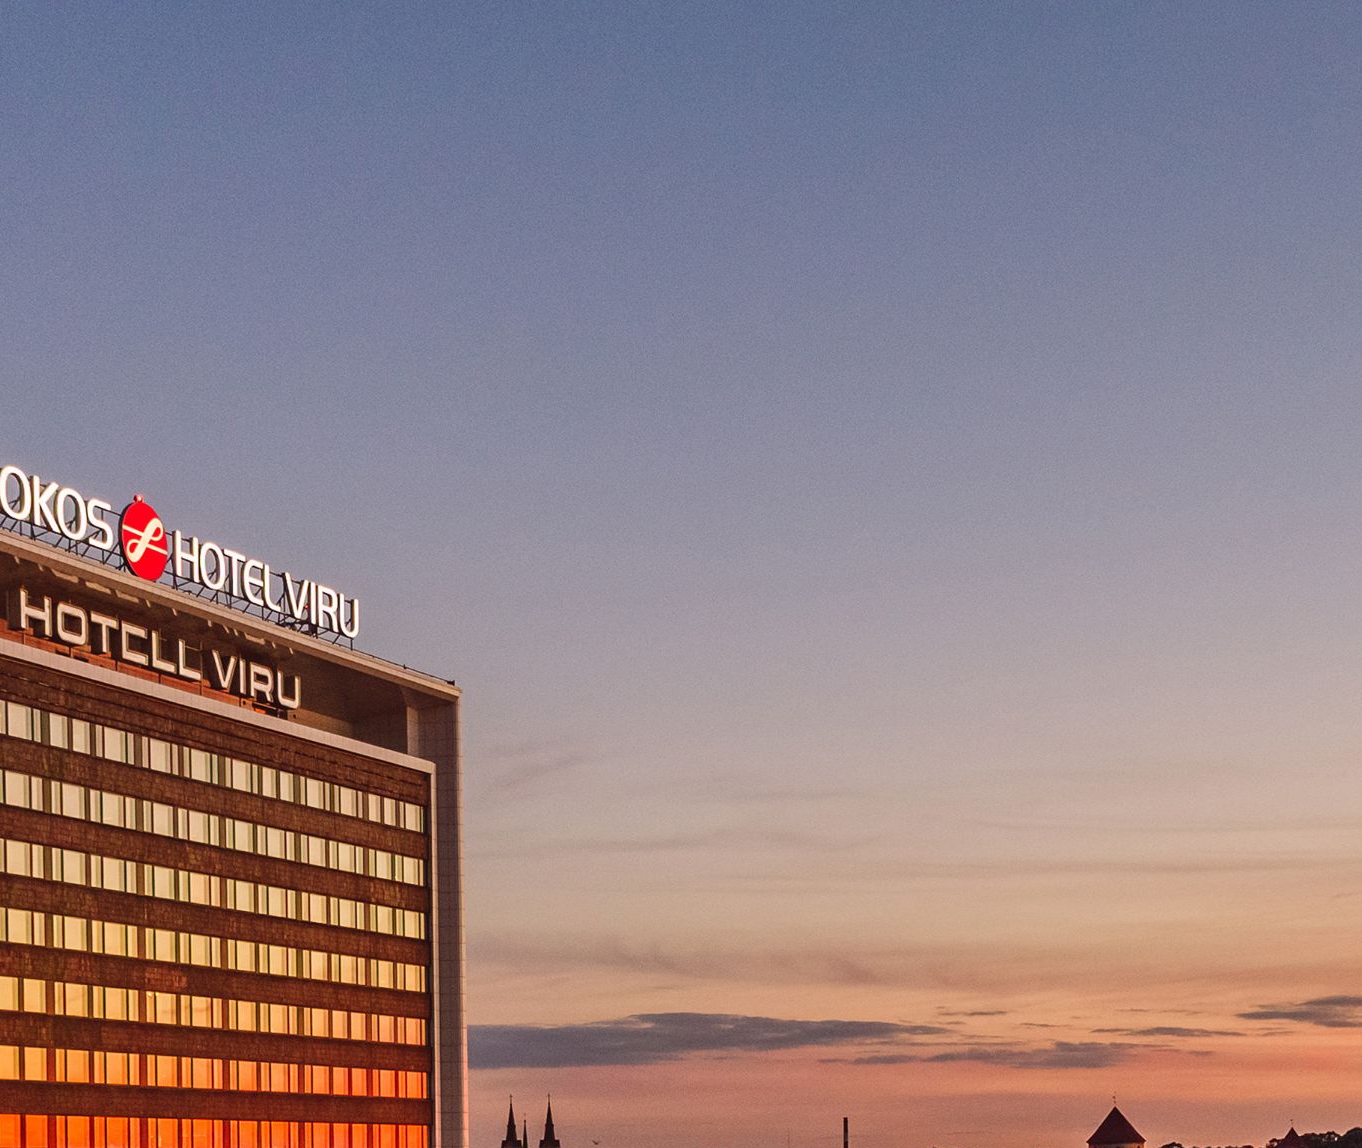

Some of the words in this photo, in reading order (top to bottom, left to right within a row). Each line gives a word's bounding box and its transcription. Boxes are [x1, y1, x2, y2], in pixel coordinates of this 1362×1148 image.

[174, 529, 281, 613] HOTEL
[284, 571, 359, 639] VIRU
[19, 588, 203, 681] HOTELL
[210, 649, 301, 710] VIRU
